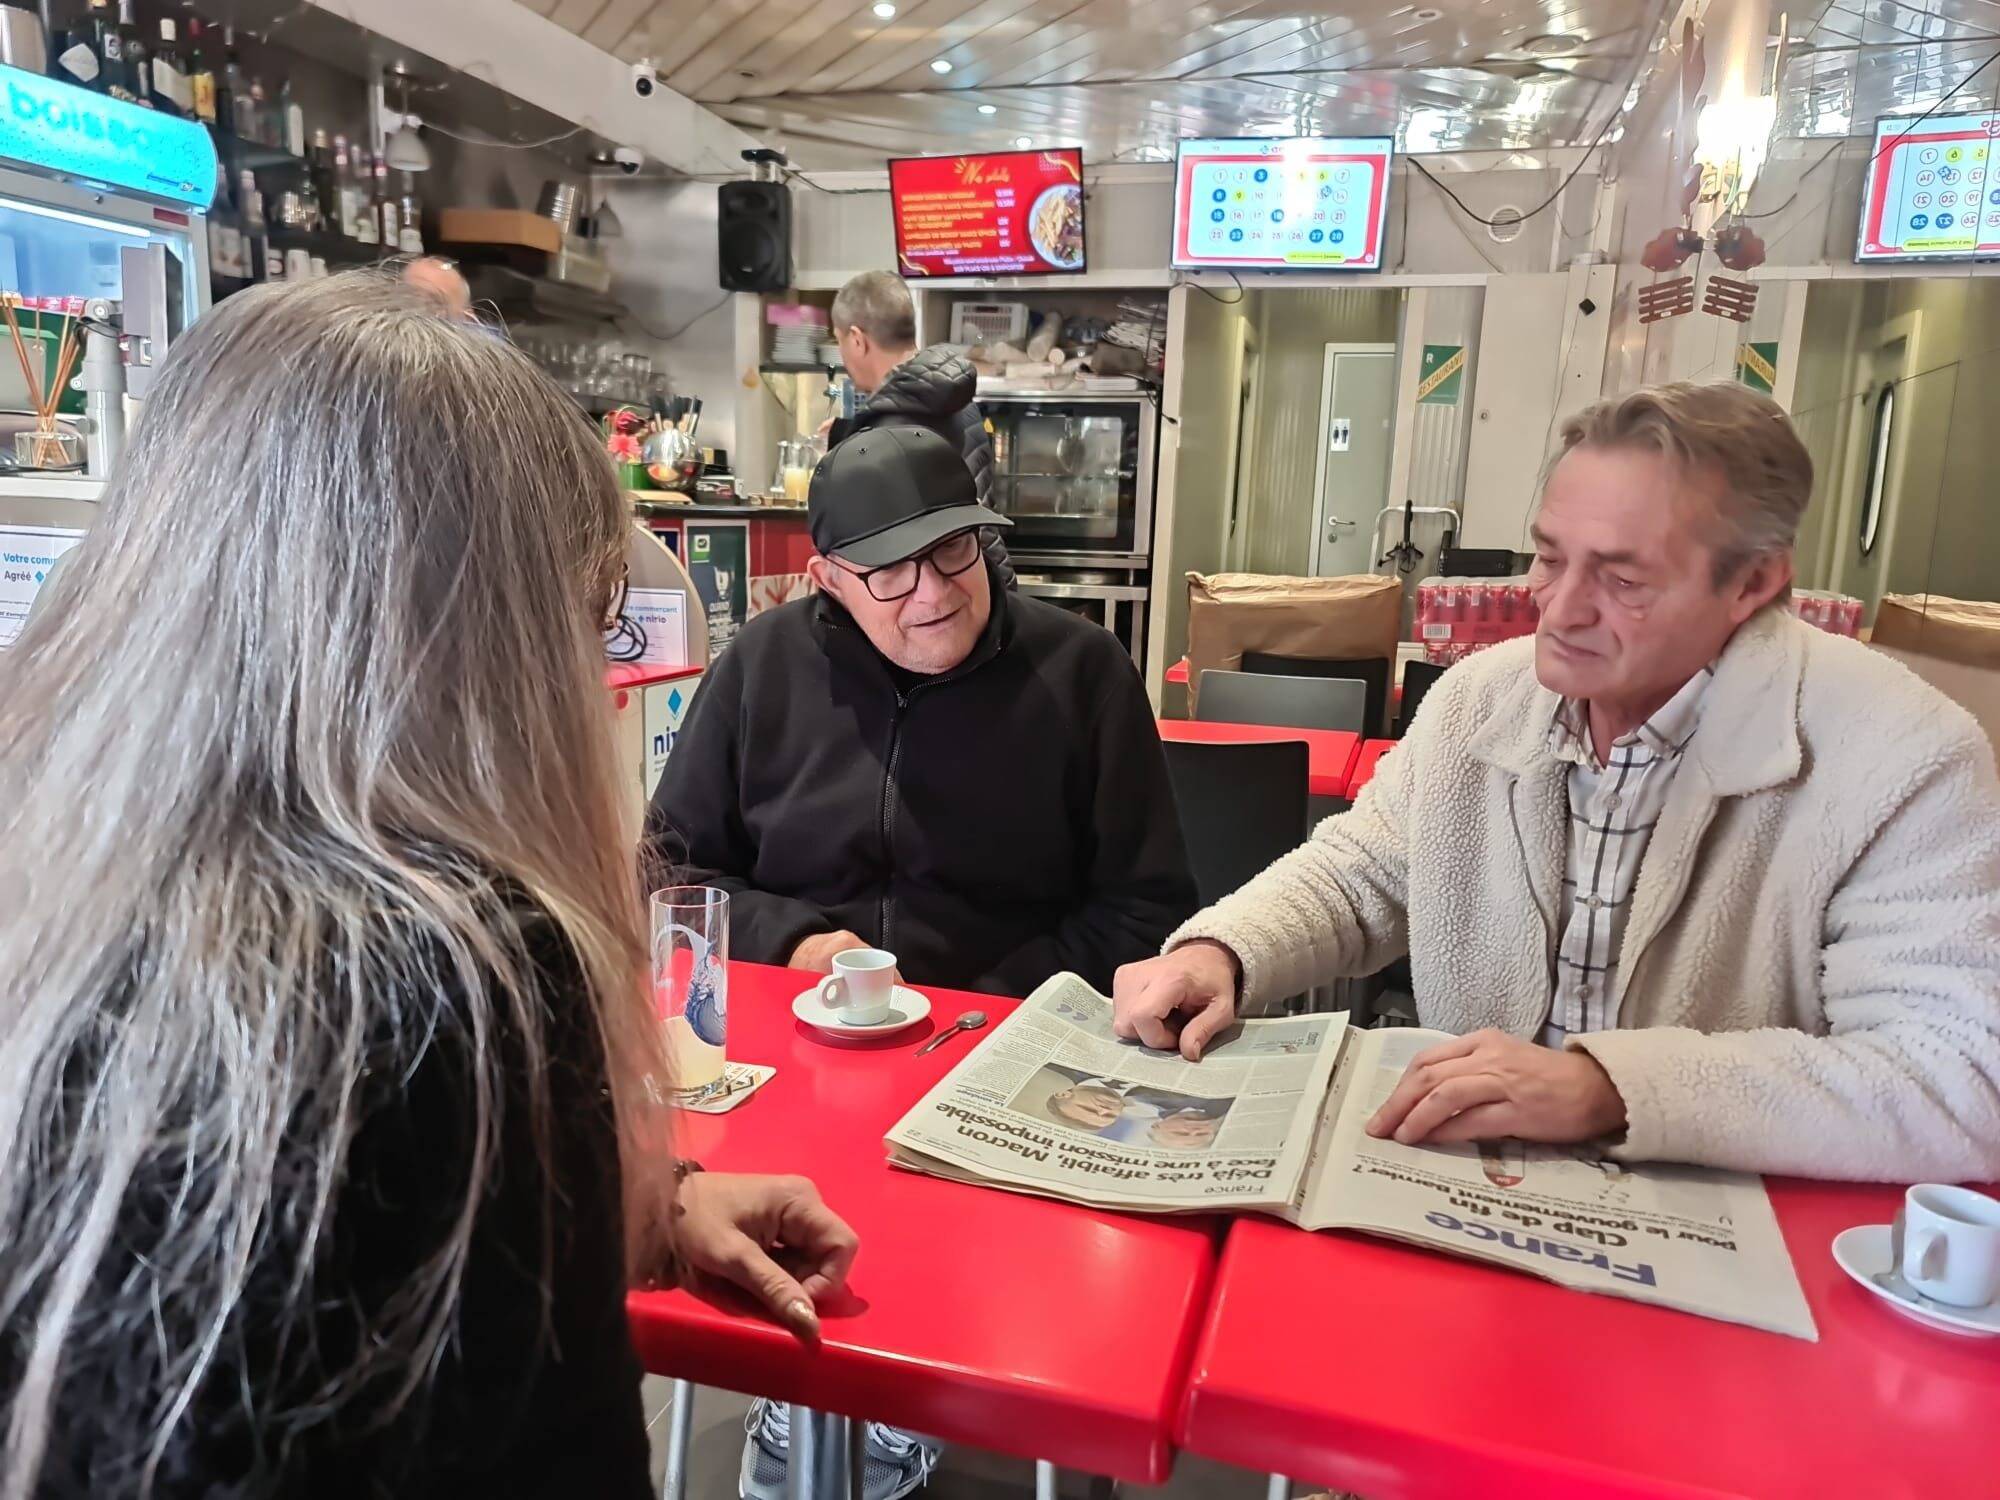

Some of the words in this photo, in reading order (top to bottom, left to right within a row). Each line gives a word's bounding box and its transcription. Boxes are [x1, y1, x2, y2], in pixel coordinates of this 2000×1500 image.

[1426, 352, 1434, 364] R
[3, 552, 29, 563] Votre
[4, 570, 32, 583] Agréé
[646, 614, 667, 624] nirio
[934, 1102, 1054, 1150] impossible
[956, 1124, 1050, 1163] Macron
[1058, 1142, 1149, 1169] mission
[1226, 1158, 1277, 1168] face
[1056, 1154, 1151, 1181] affaibli,
[1156, 1171, 1204, 1183] très
[1212, 1167, 1272, 1182] Déjà
[1203, 1184, 1265, 1195] France
[1447, 1196, 1492, 1217] fin
[1456, 1187, 1638, 1234] gouvernement
[1501, 1210, 1543, 1230] de
[1552, 1218, 1629, 1248] Clap
[1645, 1226, 1670, 1240] le
[1676, 1230, 1738, 1252] pour
[1424, 1210, 1657, 1288] France
